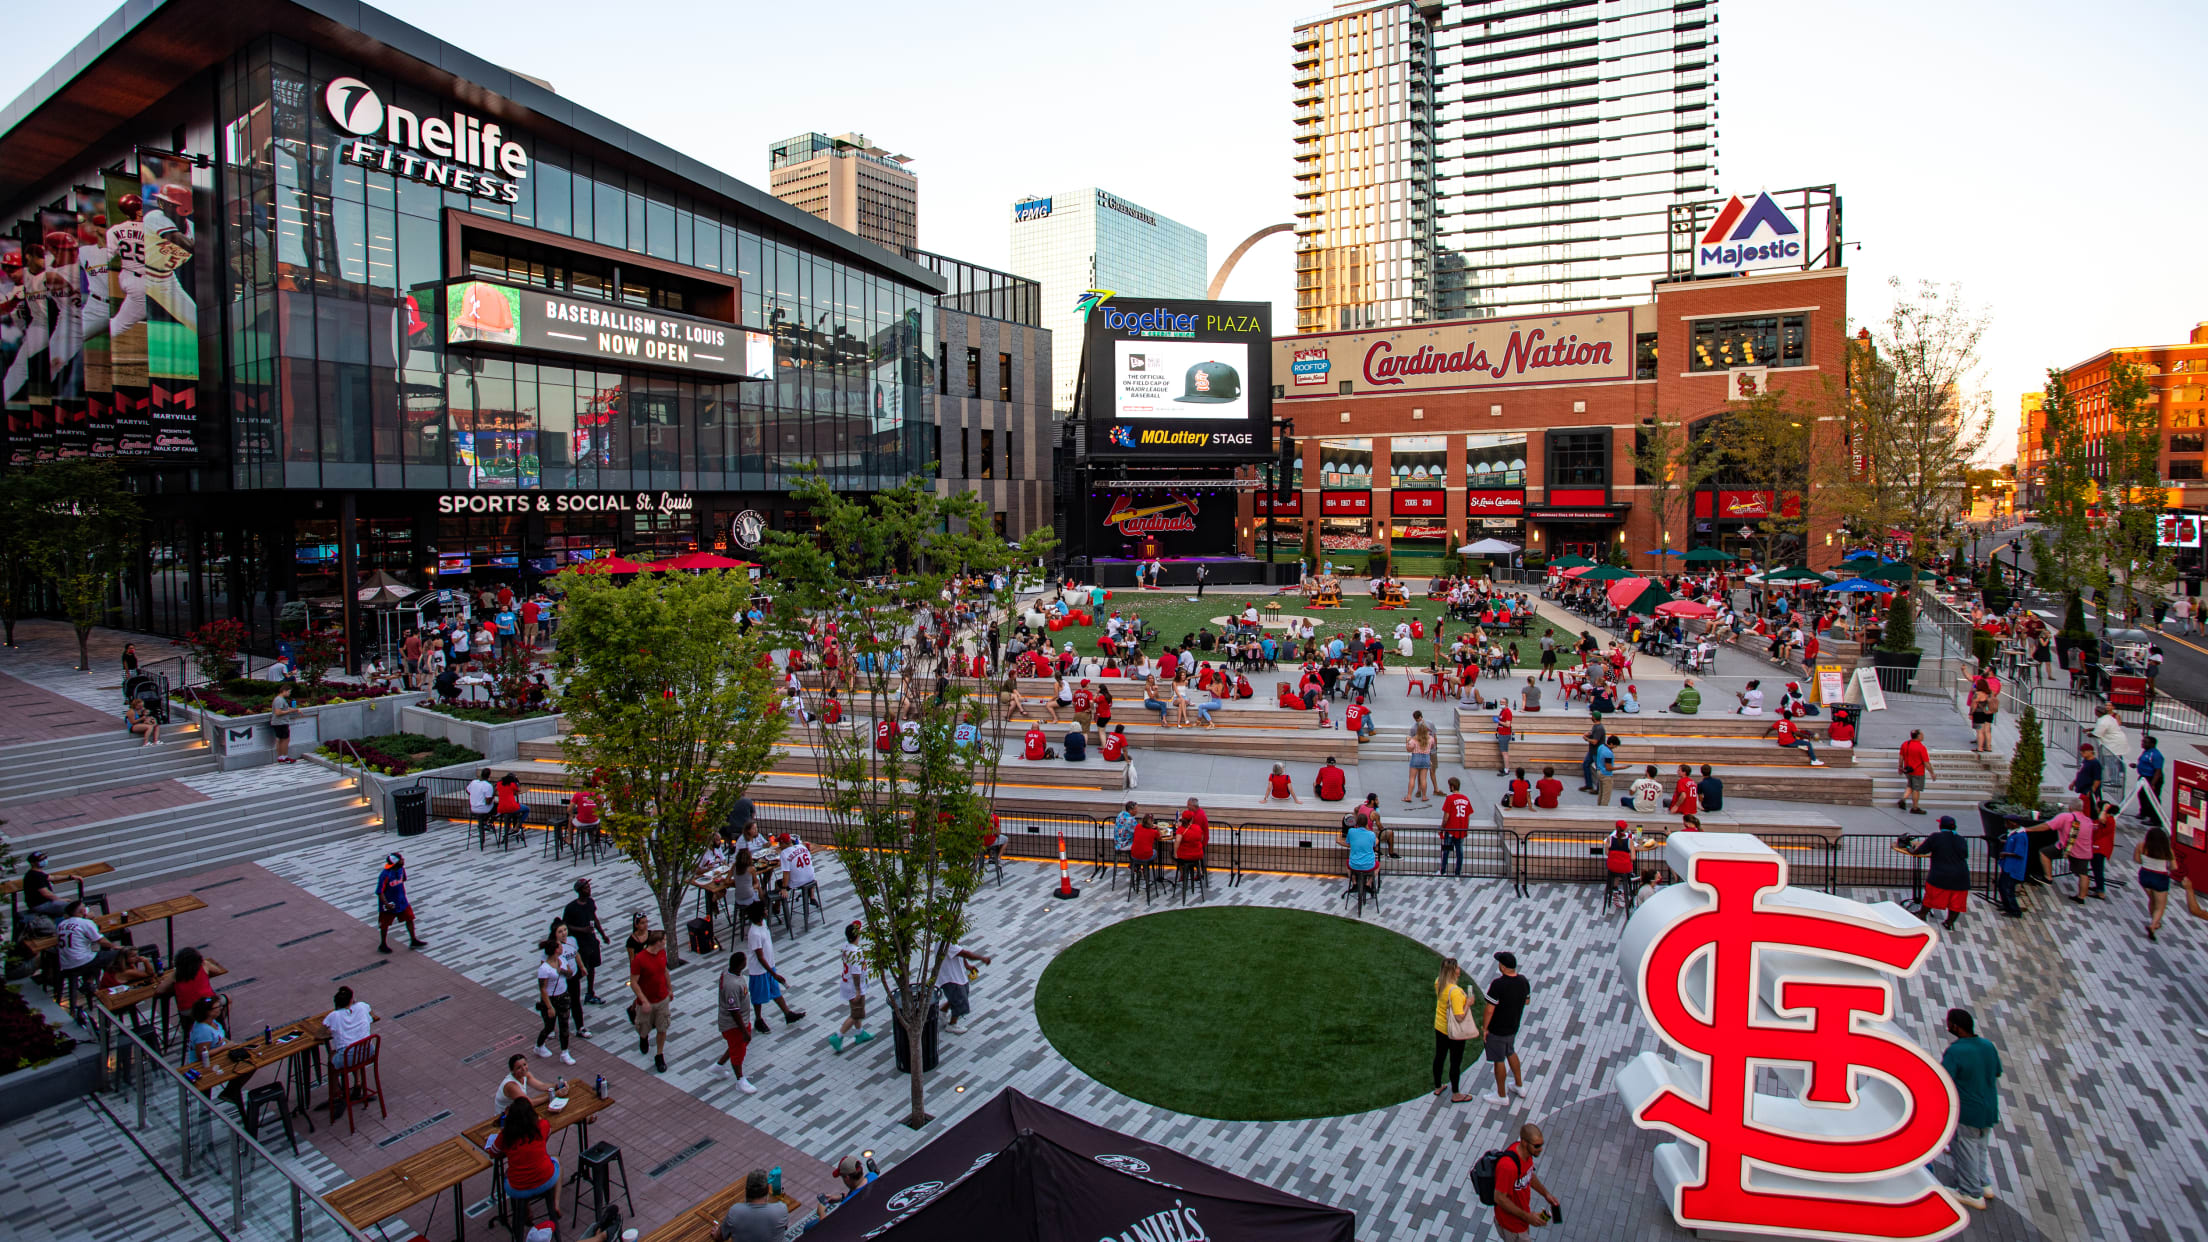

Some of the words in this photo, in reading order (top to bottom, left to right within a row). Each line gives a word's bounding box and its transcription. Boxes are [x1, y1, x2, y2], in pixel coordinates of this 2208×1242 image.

[325, 77, 527, 178] Onelife
[351, 141, 519, 203] FITNESS
[1015, 205, 1048, 223] KPMG
[1701, 240, 1799, 268] Majestic
[546, 301, 656, 335] BASEBALLISM
[661, 321, 681, 340] ST.
[686, 326, 725, 346] LOUIS
[1099, 307, 1198, 335] Together
[1207, 315, 1261, 332] PLAZA
[598, 332, 639, 356] NOW
[646, 341, 688, 362] OPEN
[1363, 340, 1492, 385] Cardinals
[1490, 328, 1613, 379] Nation
[1295, 363, 1327, 371] ROOFTOP
[153, 413, 197, 421] MARYVILLE
[1140, 430, 1209, 446] MOLottery
[1213, 434, 1253, 444] STAGE
[439, 495, 530, 512] SPORTS
[536, 495, 550, 511] &
[556, 495, 631, 511] SOCIAL
[636, 493, 654, 511] St.
[658, 491, 693, 516] Louis
[1495, 497, 1521, 507] Cardinals
[1118, 510, 1196, 536] Cardinals
[1348, 710, 1358, 719] 50
[880, 724, 888, 737] 2
[957, 730, 969, 740] 22
[1779, 725, 1788, 733] 23
[1028, 739, 1034, 749] 4
[1643, 789, 1655, 801] 13
[1690, 787, 1696, 797] 13
[1456, 805, 1465, 817] 15
[796, 854, 810, 868] 46
[58, 933, 73, 949] 51
[1098, 1198, 1206, 1242] NIEL'S
